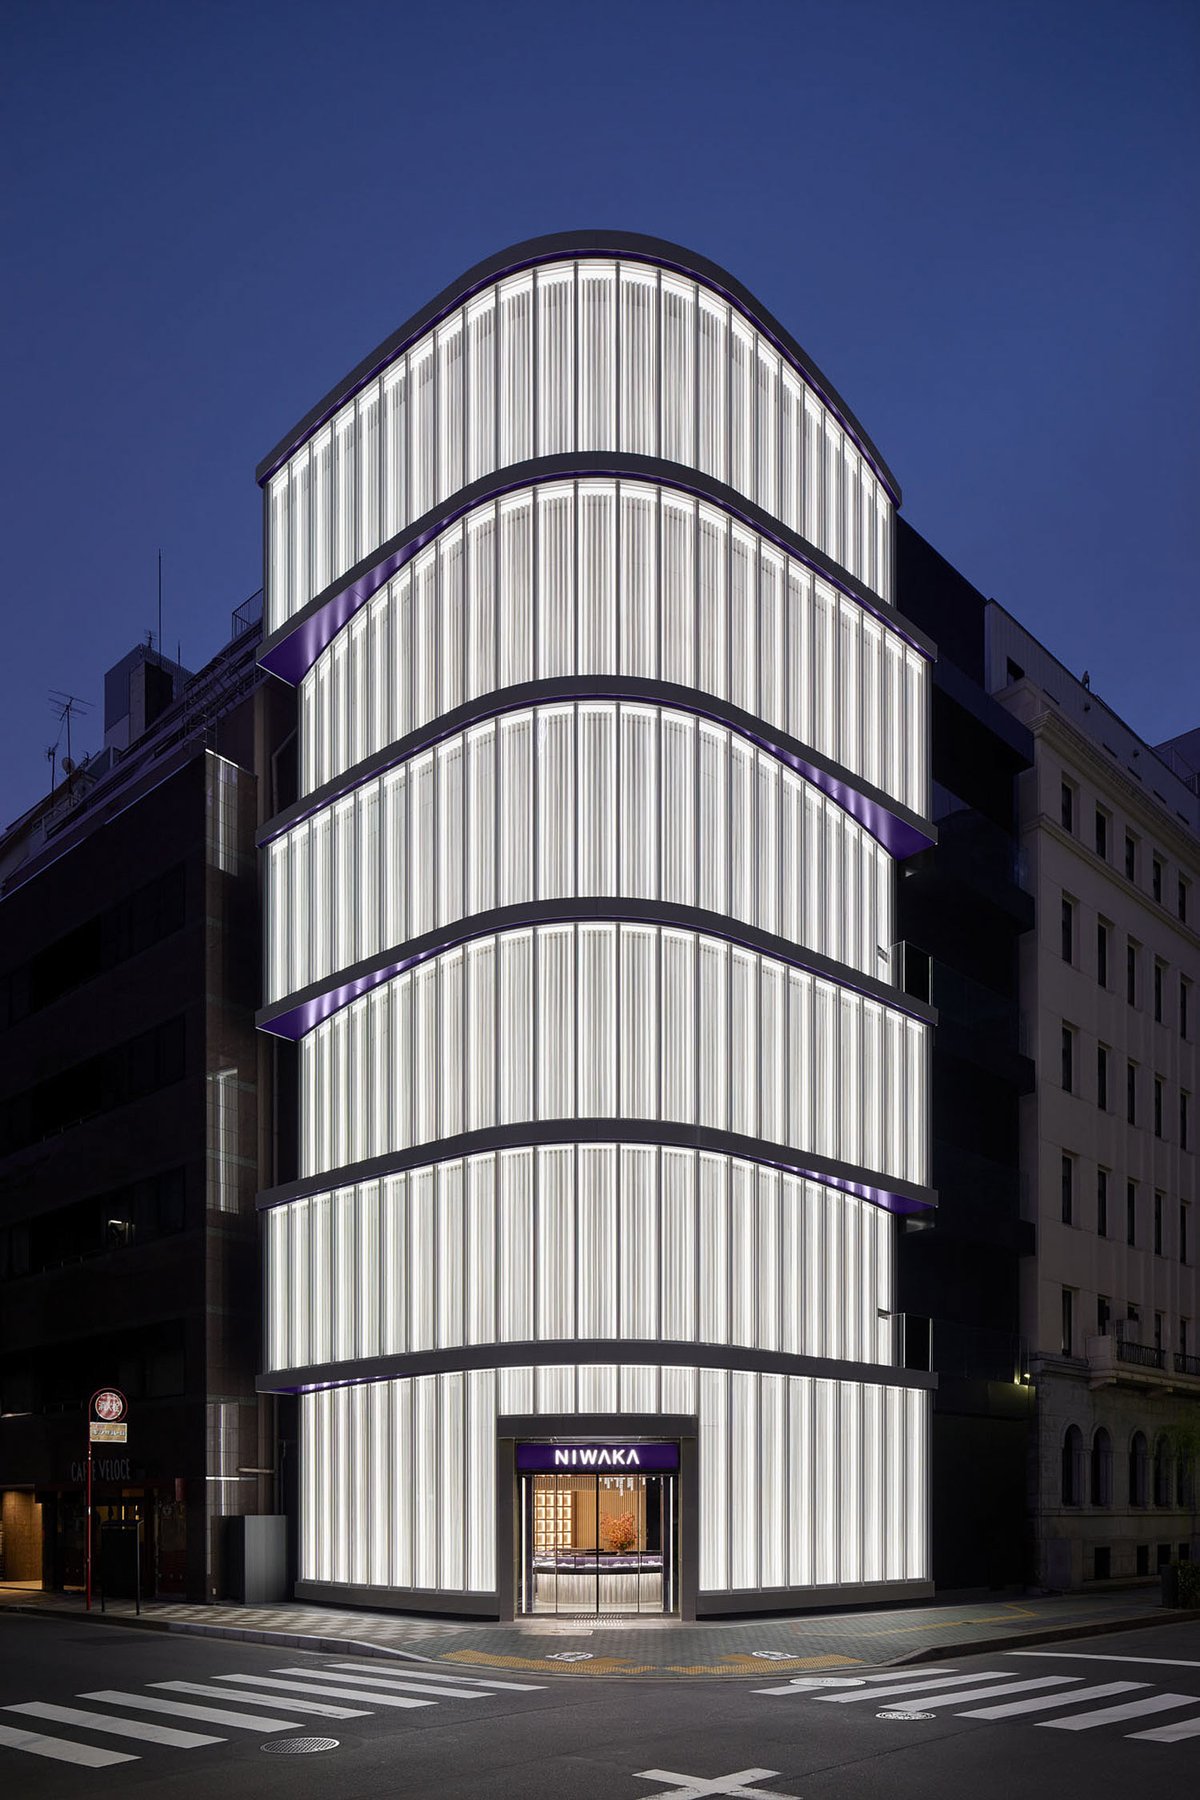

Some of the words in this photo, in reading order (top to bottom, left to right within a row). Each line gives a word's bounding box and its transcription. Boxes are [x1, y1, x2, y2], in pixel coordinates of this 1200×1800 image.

[554, 1448, 640, 1466] NIWAKA
[71, 1461, 96, 1482] CAFE
[98, 1458, 130, 1481] VELOCE
